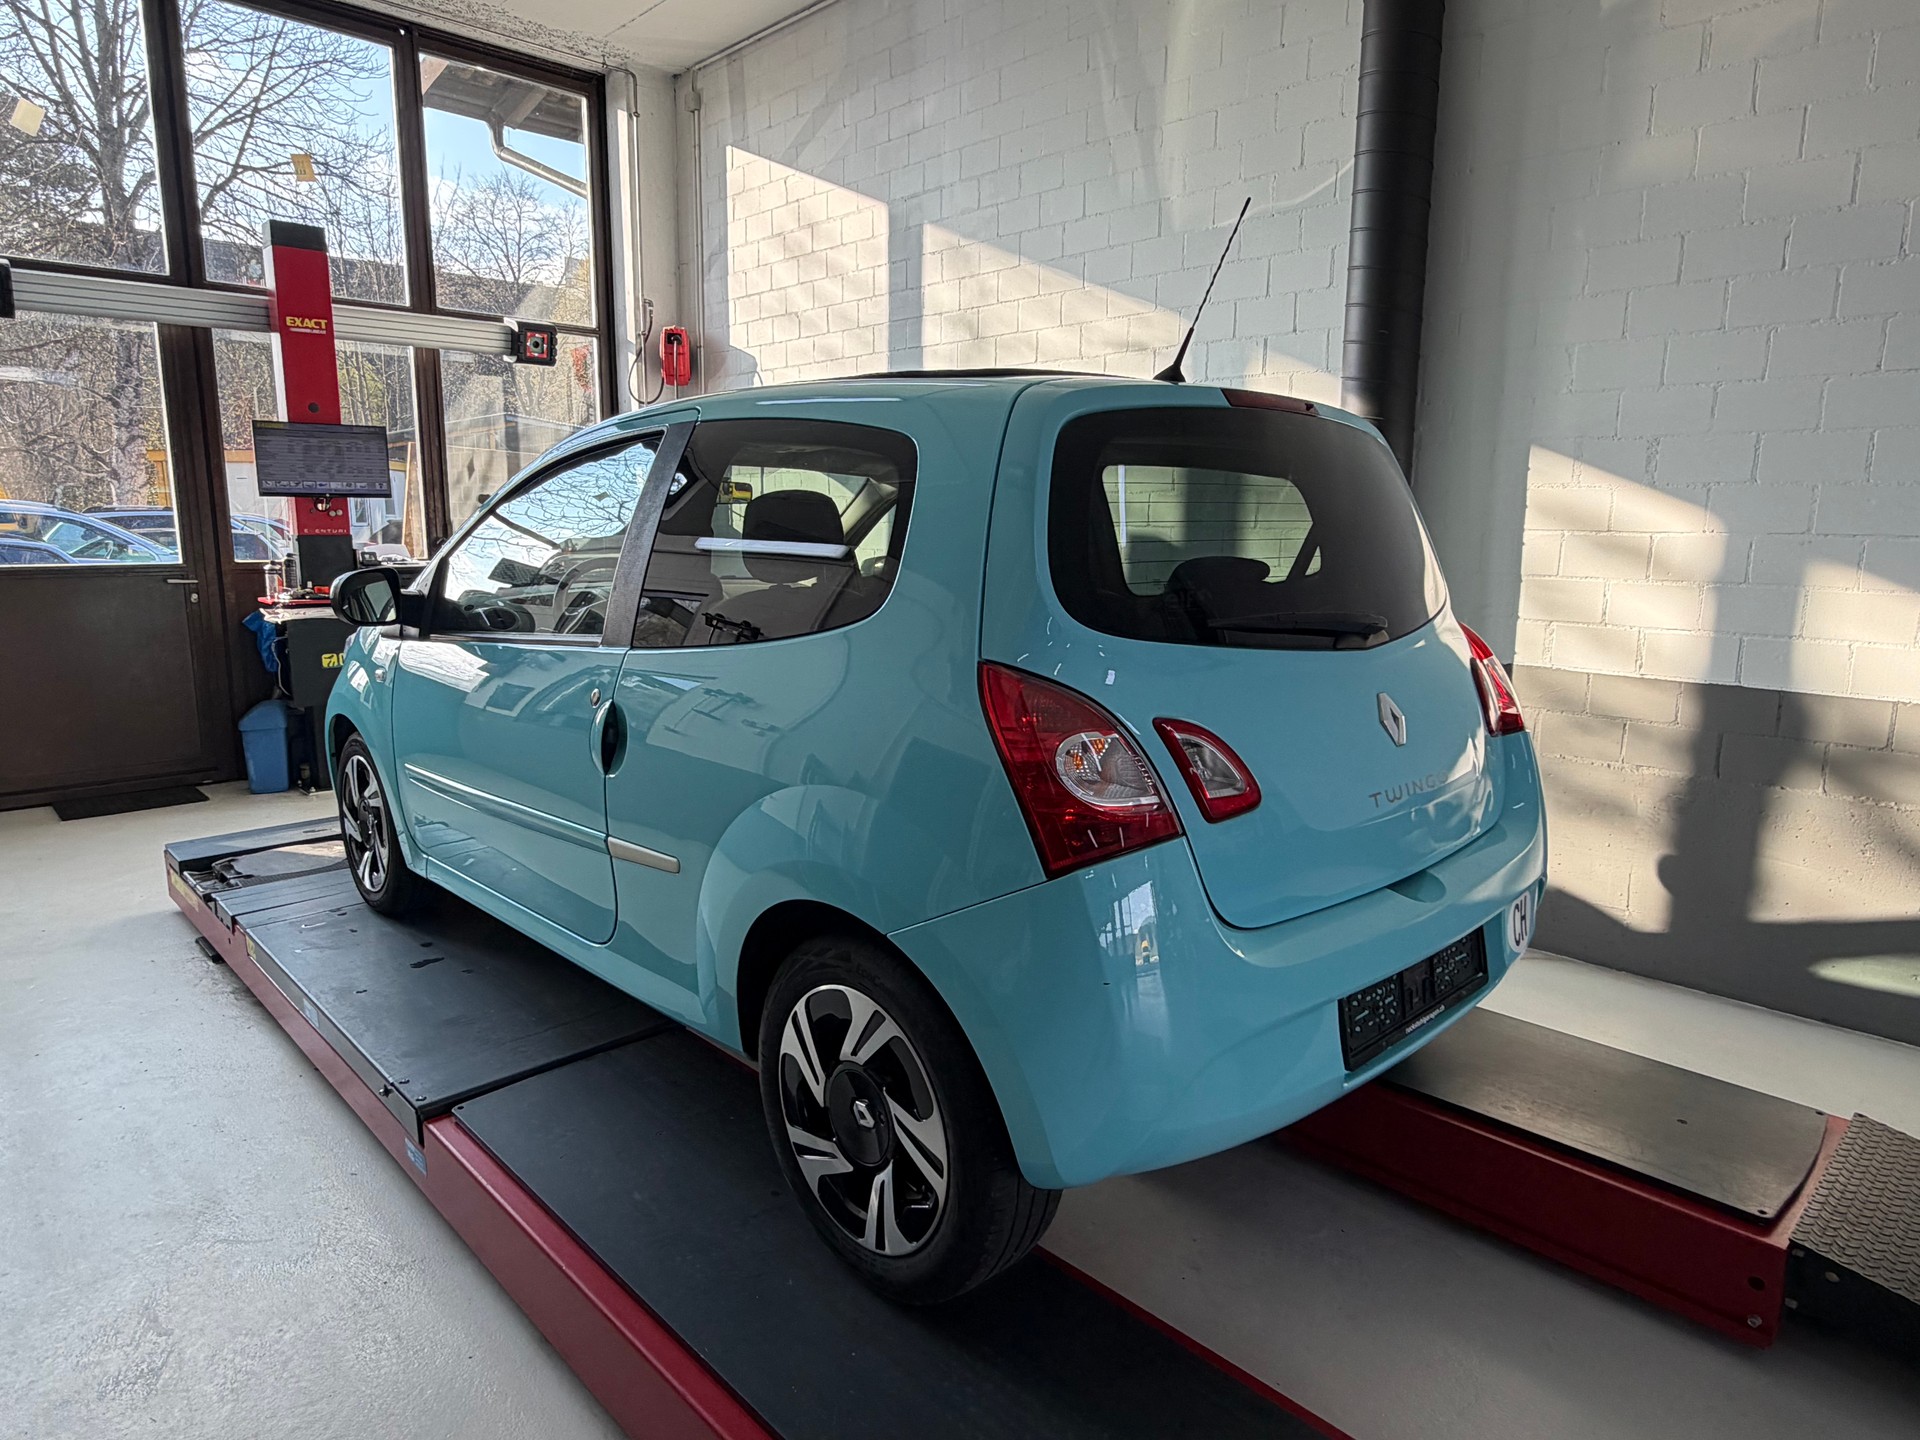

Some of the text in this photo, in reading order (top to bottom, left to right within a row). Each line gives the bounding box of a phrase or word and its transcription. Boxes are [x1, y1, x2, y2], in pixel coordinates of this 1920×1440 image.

[286, 316, 328, 329] EXACT
[1368, 770, 1449, 808] TWINGO
[1513, 895, 1528, 947] CH
